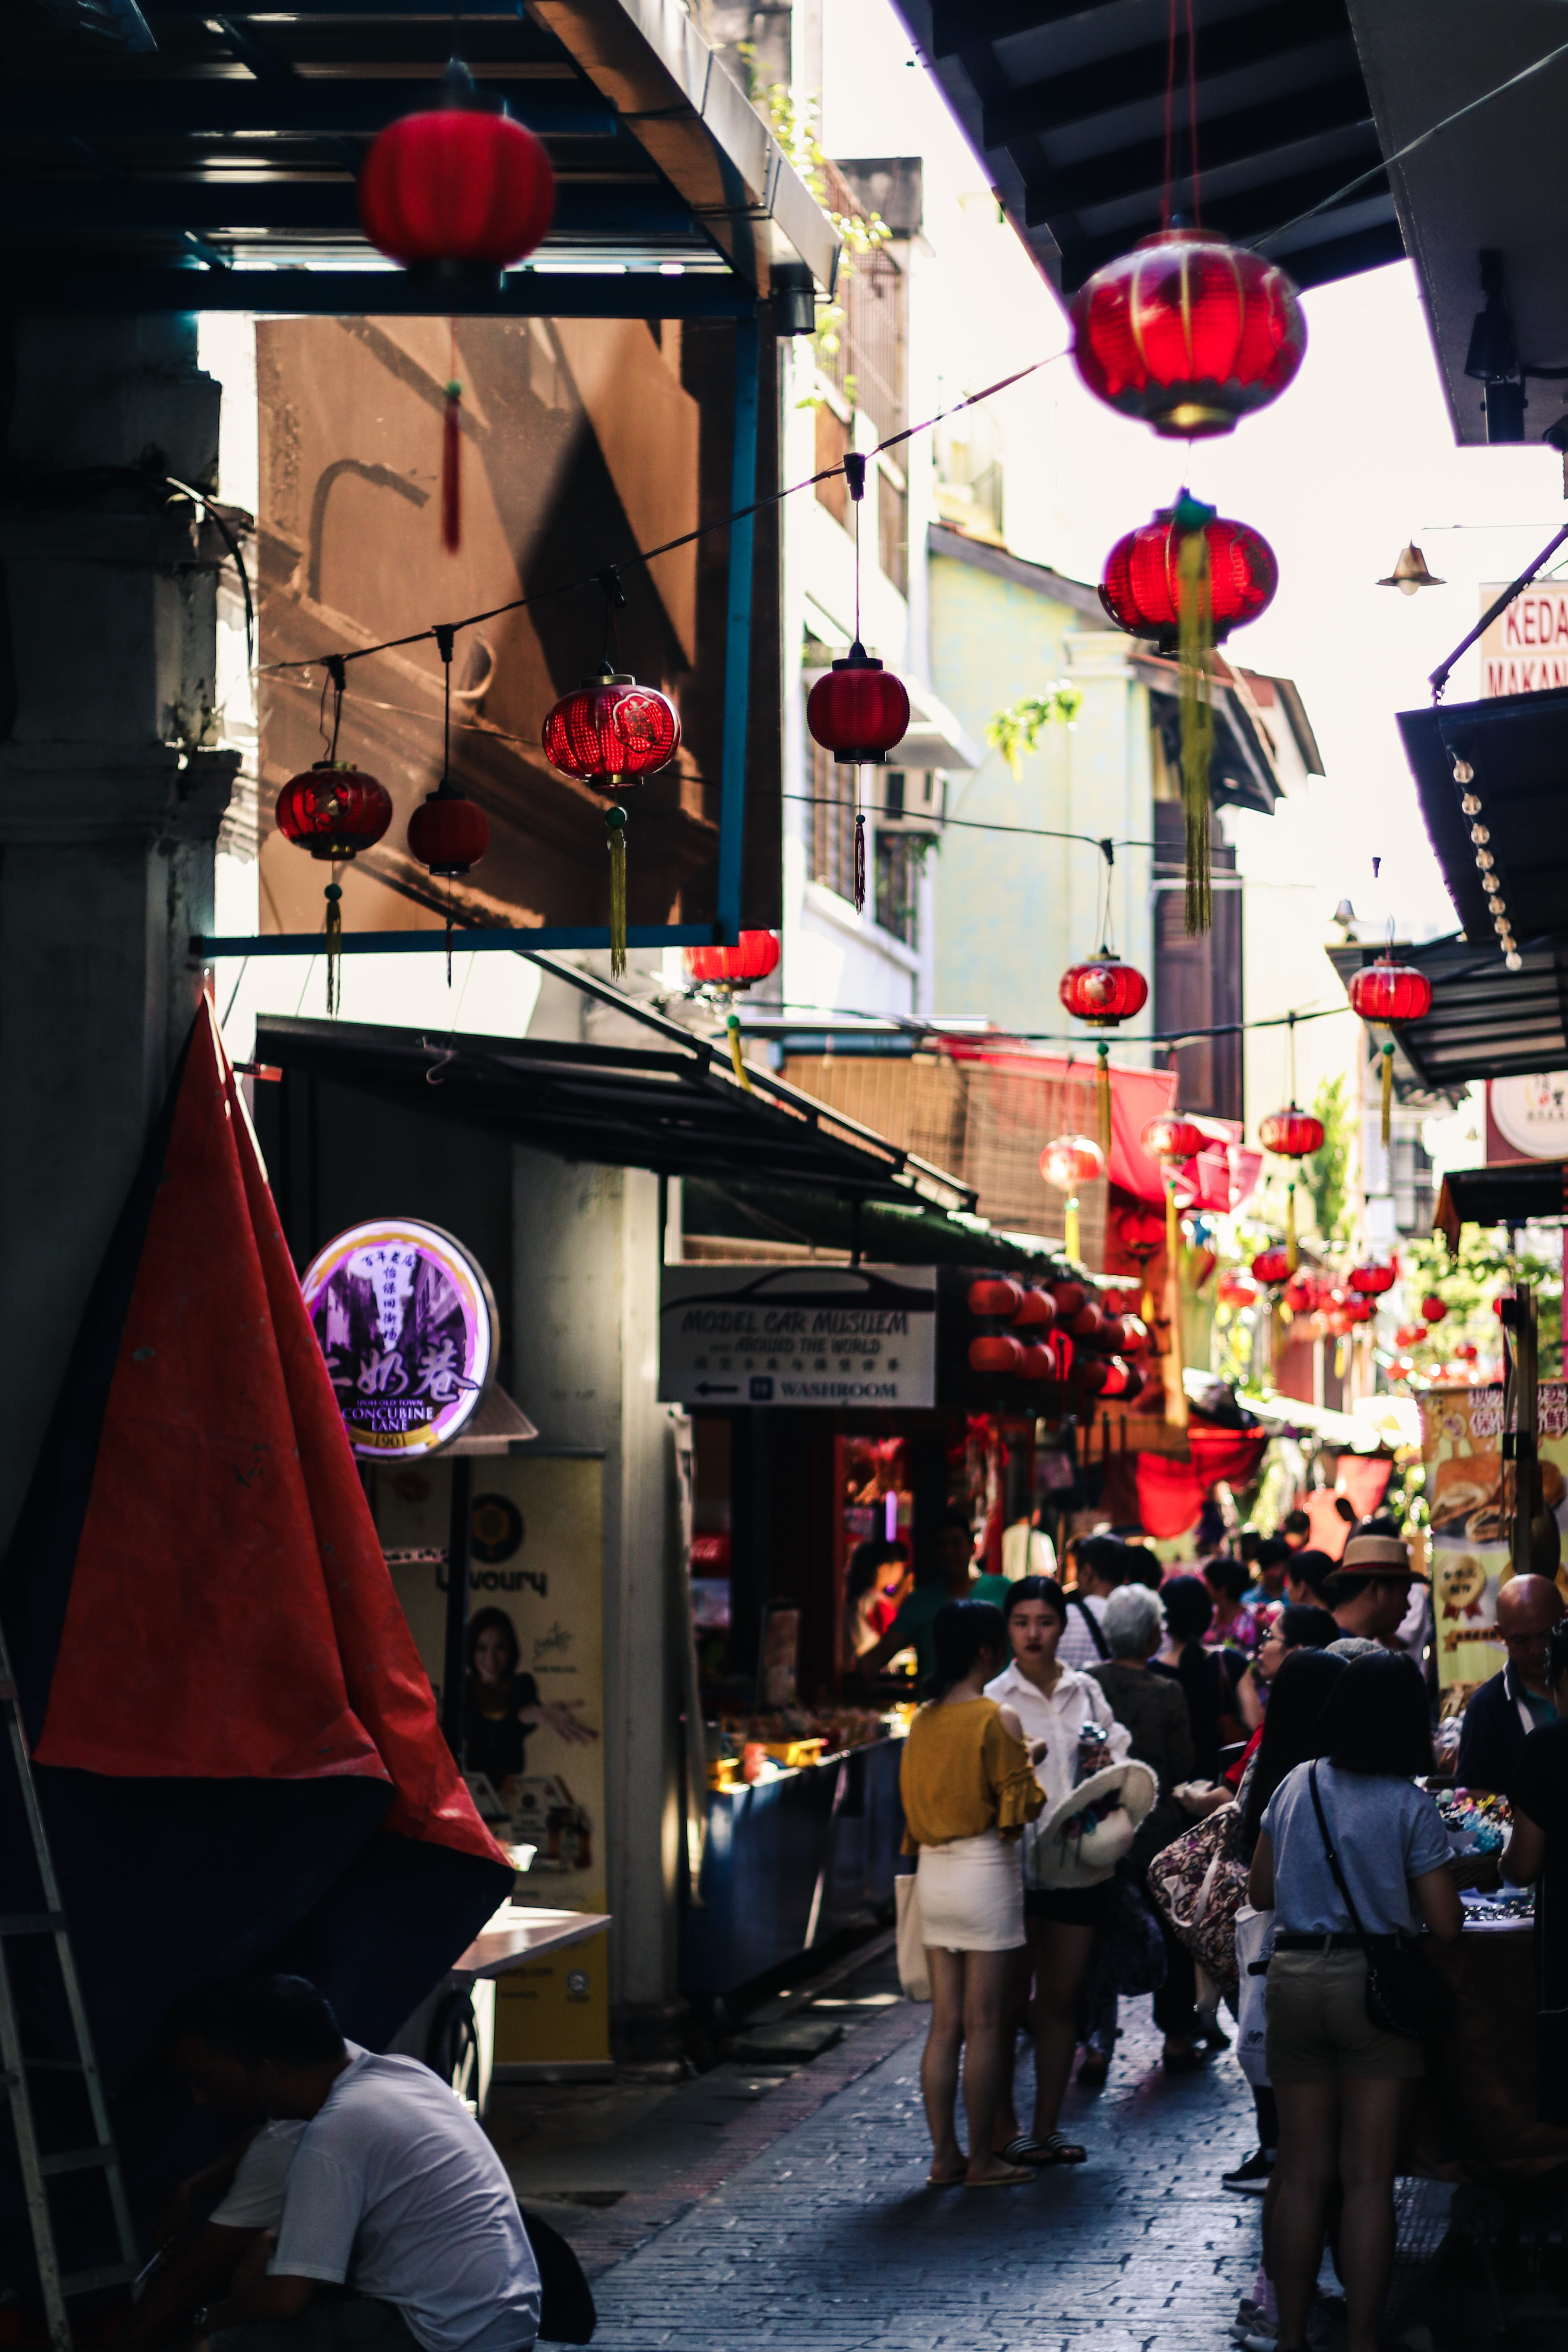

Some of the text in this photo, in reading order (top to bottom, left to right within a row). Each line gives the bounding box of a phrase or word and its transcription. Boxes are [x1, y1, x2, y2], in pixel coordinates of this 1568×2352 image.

[682, 1310, 757, 1332] MODEL
[764, 1311, 806, 1333] CAR
[735, 1339, 794, 1353] AROUND
[800, 1339, 826, 1353] THE
[831, 1339, 881, 1354] WORLD
[781, 1383, 898, 1398] WASHROOM
[342, 1407, 434, 1421] CONCUBINE
[372, 1420, 409, 1432] LANE
[376, 1435, 406, 1447] 1901
[436, 1565, 546, 1596] Lvoury
